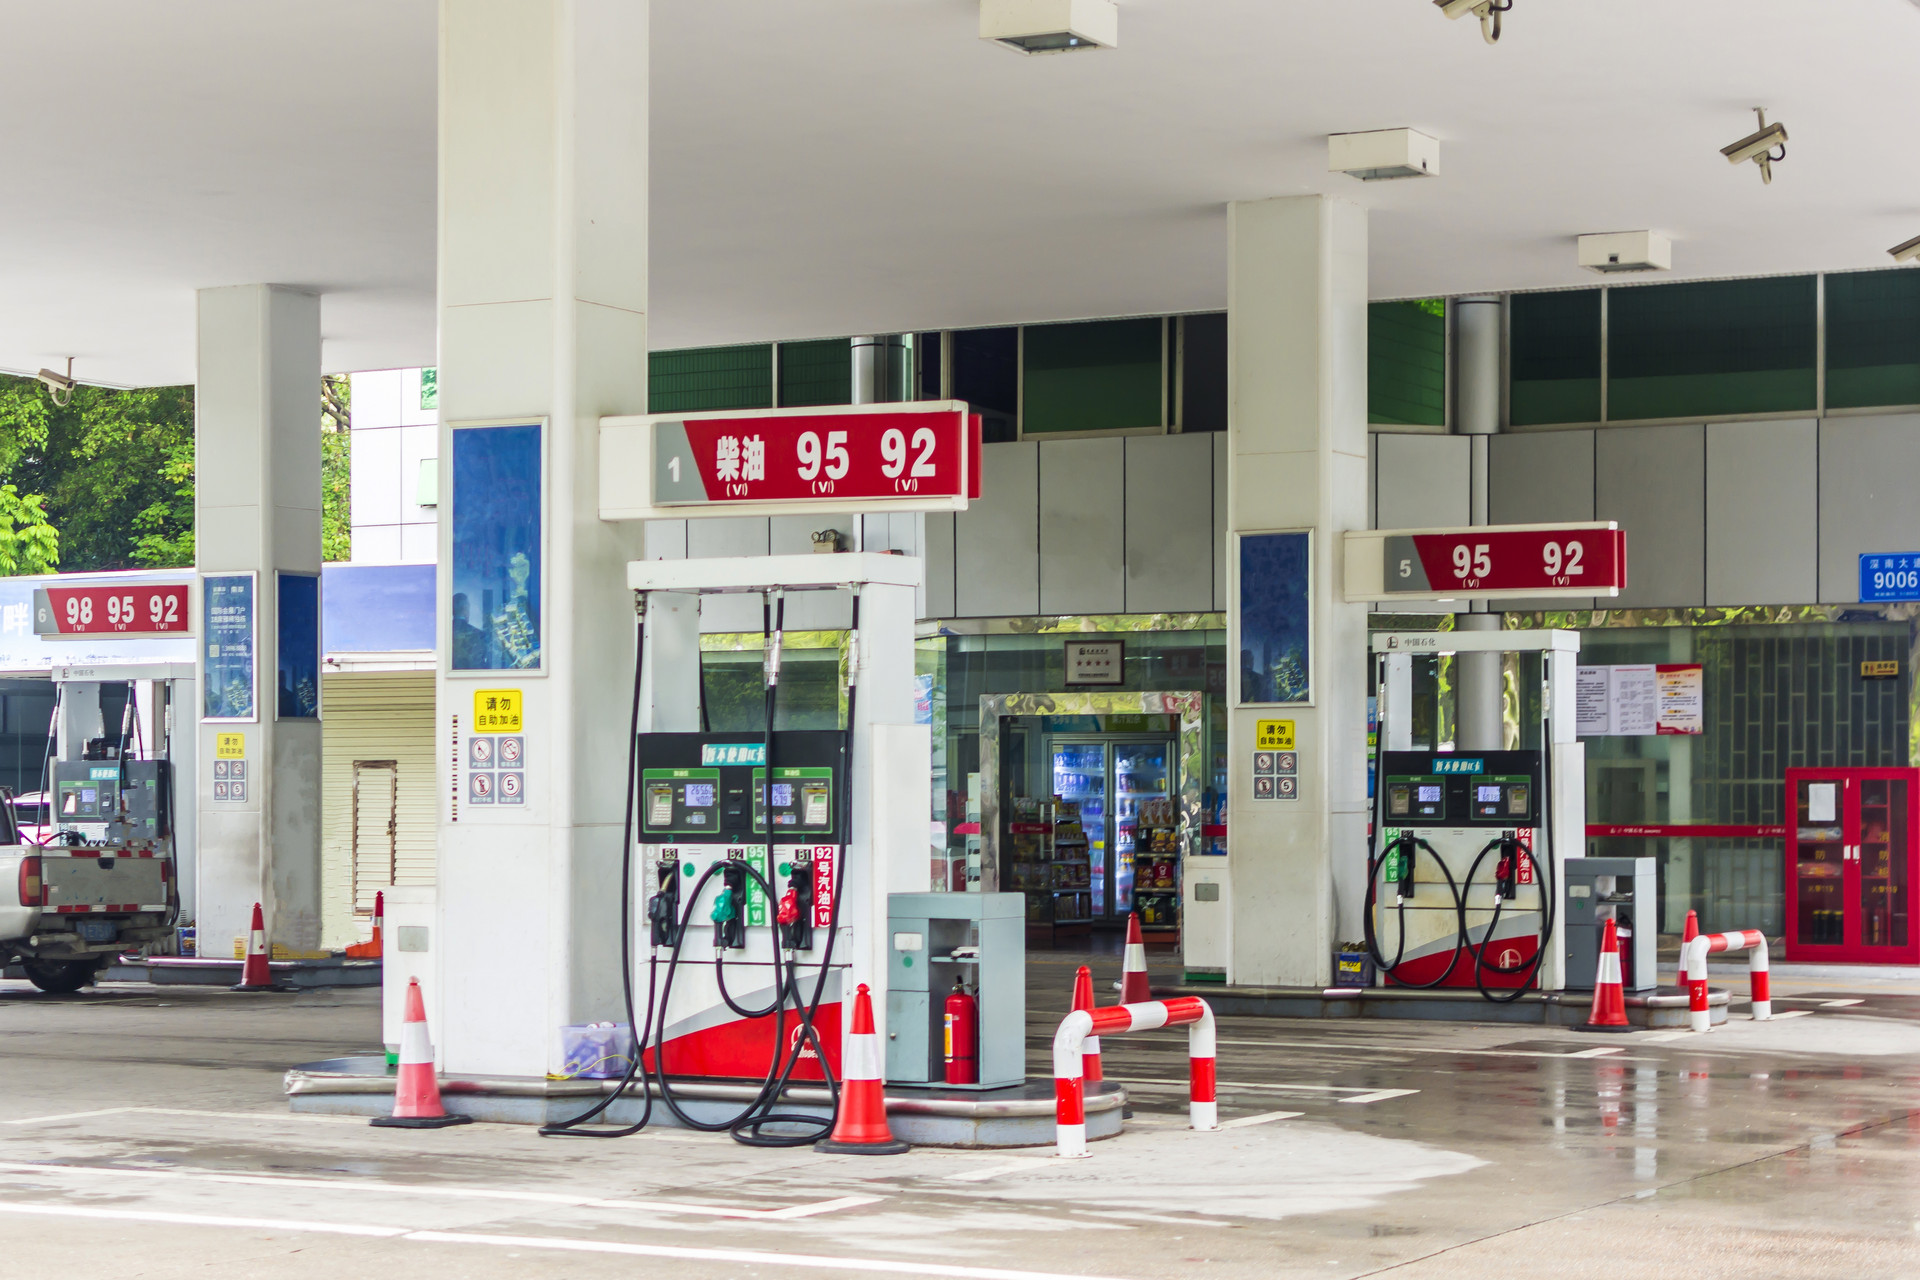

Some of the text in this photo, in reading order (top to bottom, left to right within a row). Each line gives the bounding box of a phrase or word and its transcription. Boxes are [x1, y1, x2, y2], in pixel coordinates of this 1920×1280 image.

[667, 427, 937, 483] 1 柴油 95 92
[1399, 540, 1584, 579] 5 95 92
[1874, 571, 1918, 589] 9006
[38, 594, 179, 625] 6 98 95 92
[0, 602, 29, 637] 畔
[1404, 637, 1436, 647] 中国石化
[486, 697, 511, 712] 请勿
[479, 714, 519, 726] 自助加油
[1266, 724, 1287, 735] 请勿
[1260, 736, 1292, 745] 自助加油
[706, 746, 765, 763] 暂不使用IC卡
[1435, 760, 1481, 772] 暂不使用IC卡
[235, 785, 240, 793] 5
[507, 779, 515, 791] 5
[1283, 781, 1290, 790] 5
[667, 835, 675, 844] 3
[731, 835, 739, 844] 2
[664, 848, 676, 859] B3
[729, 849, 742, 860] B2
[798, 849, 809, 860] B1
